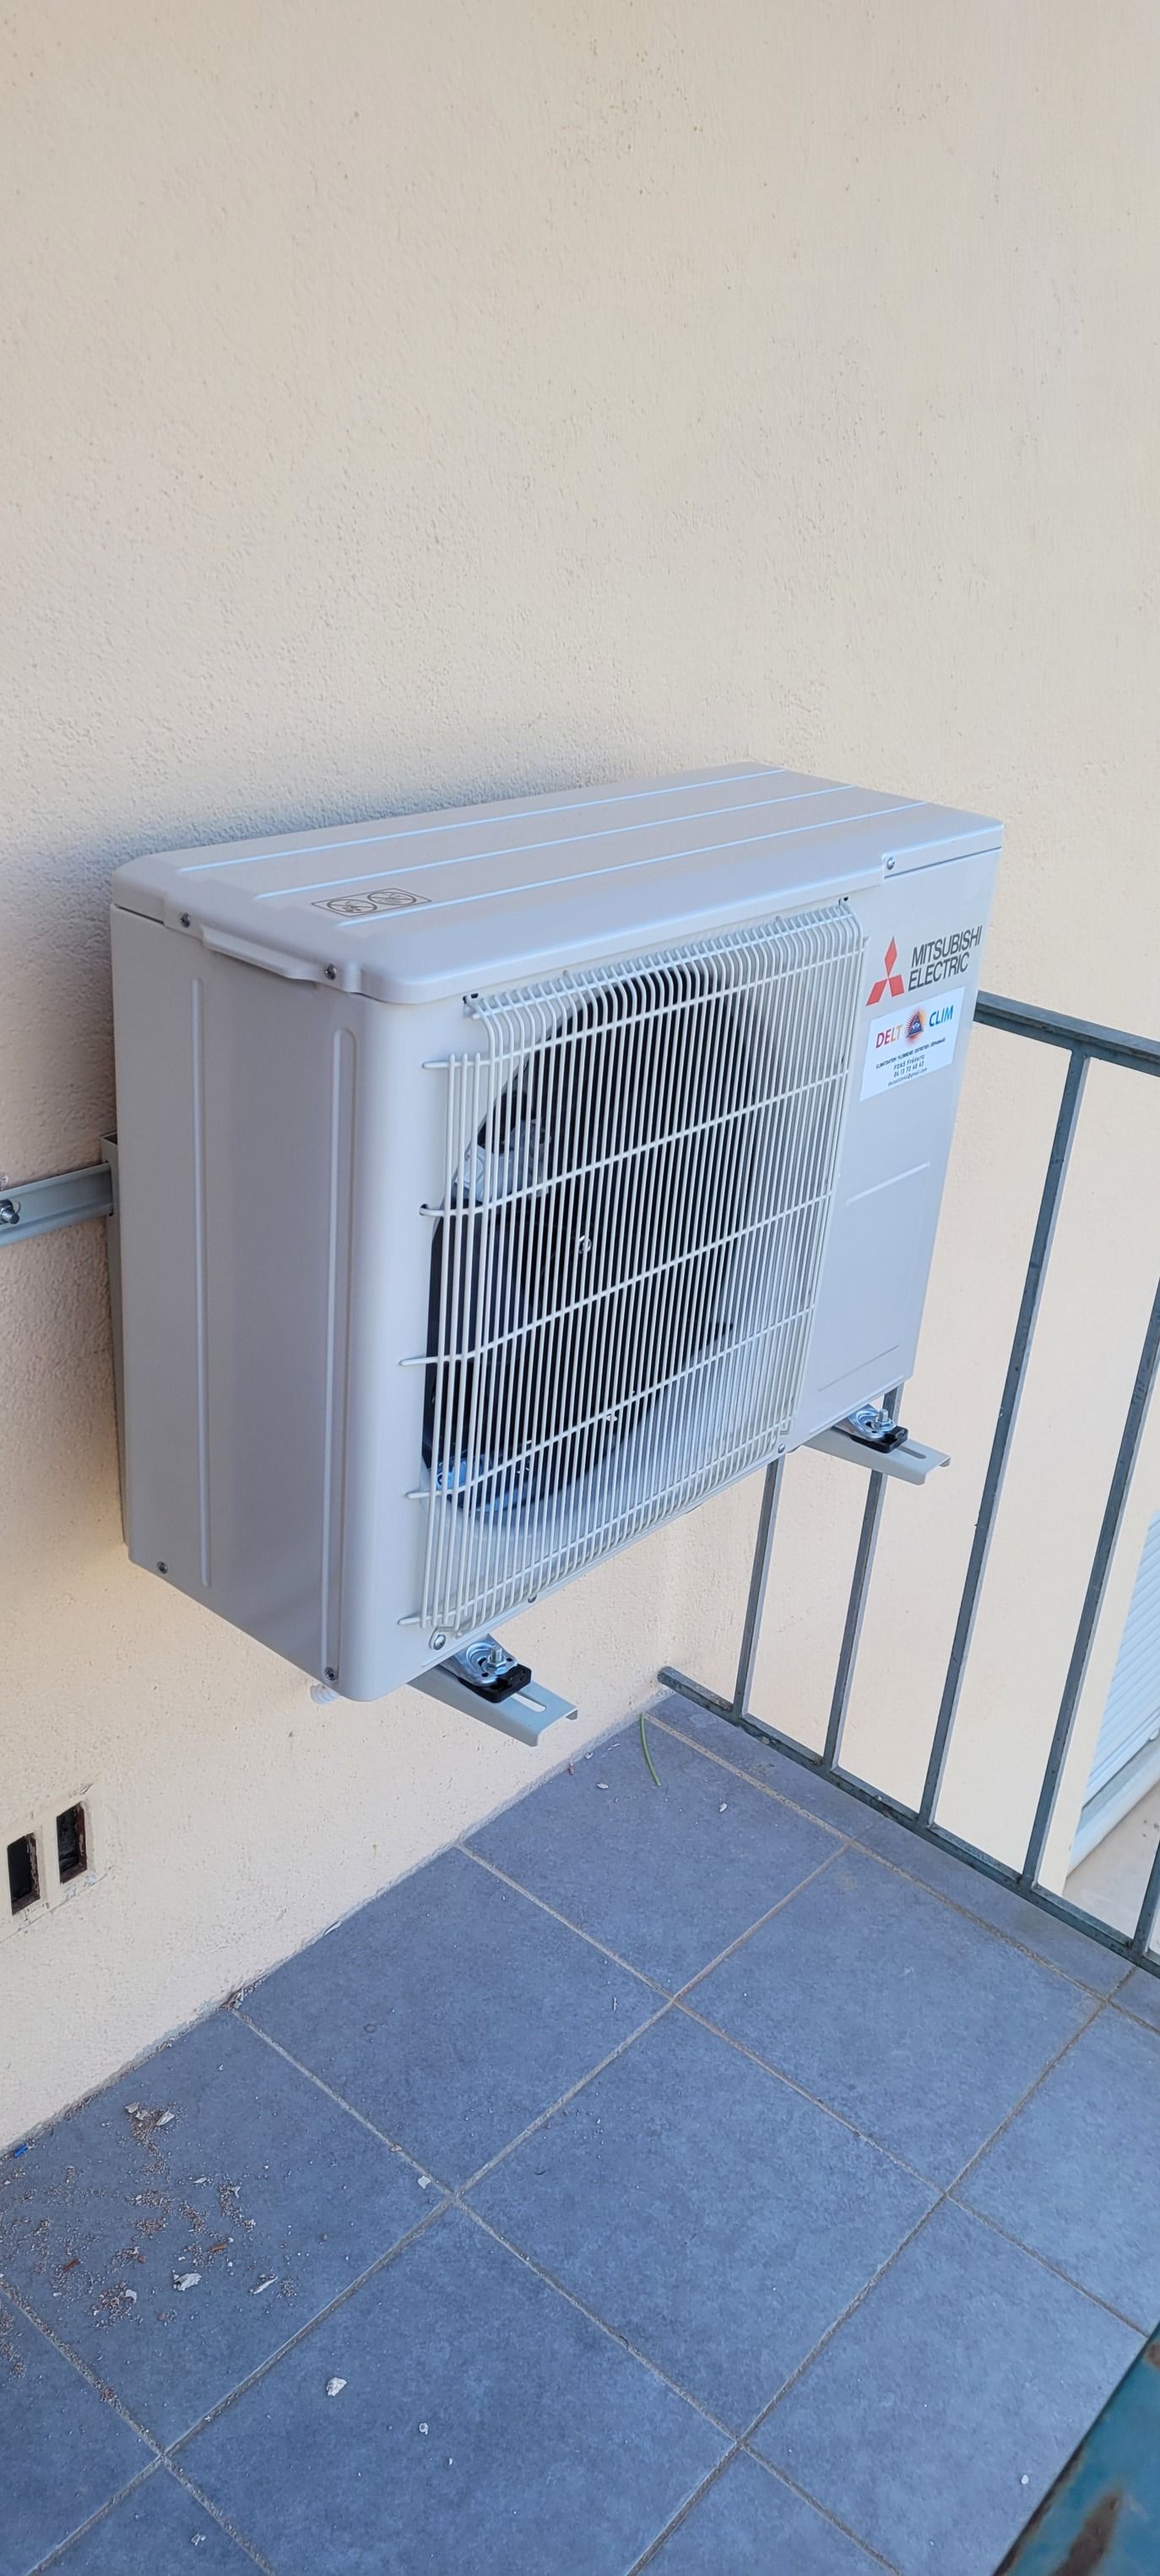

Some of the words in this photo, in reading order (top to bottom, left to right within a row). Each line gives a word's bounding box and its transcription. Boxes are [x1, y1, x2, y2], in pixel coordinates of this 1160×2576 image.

[911, 925, 983, 968] MITSUBISHI
[908, 952, 970, 992] ELECTRIC
[929, 1005, 954, 1027] CLIM
